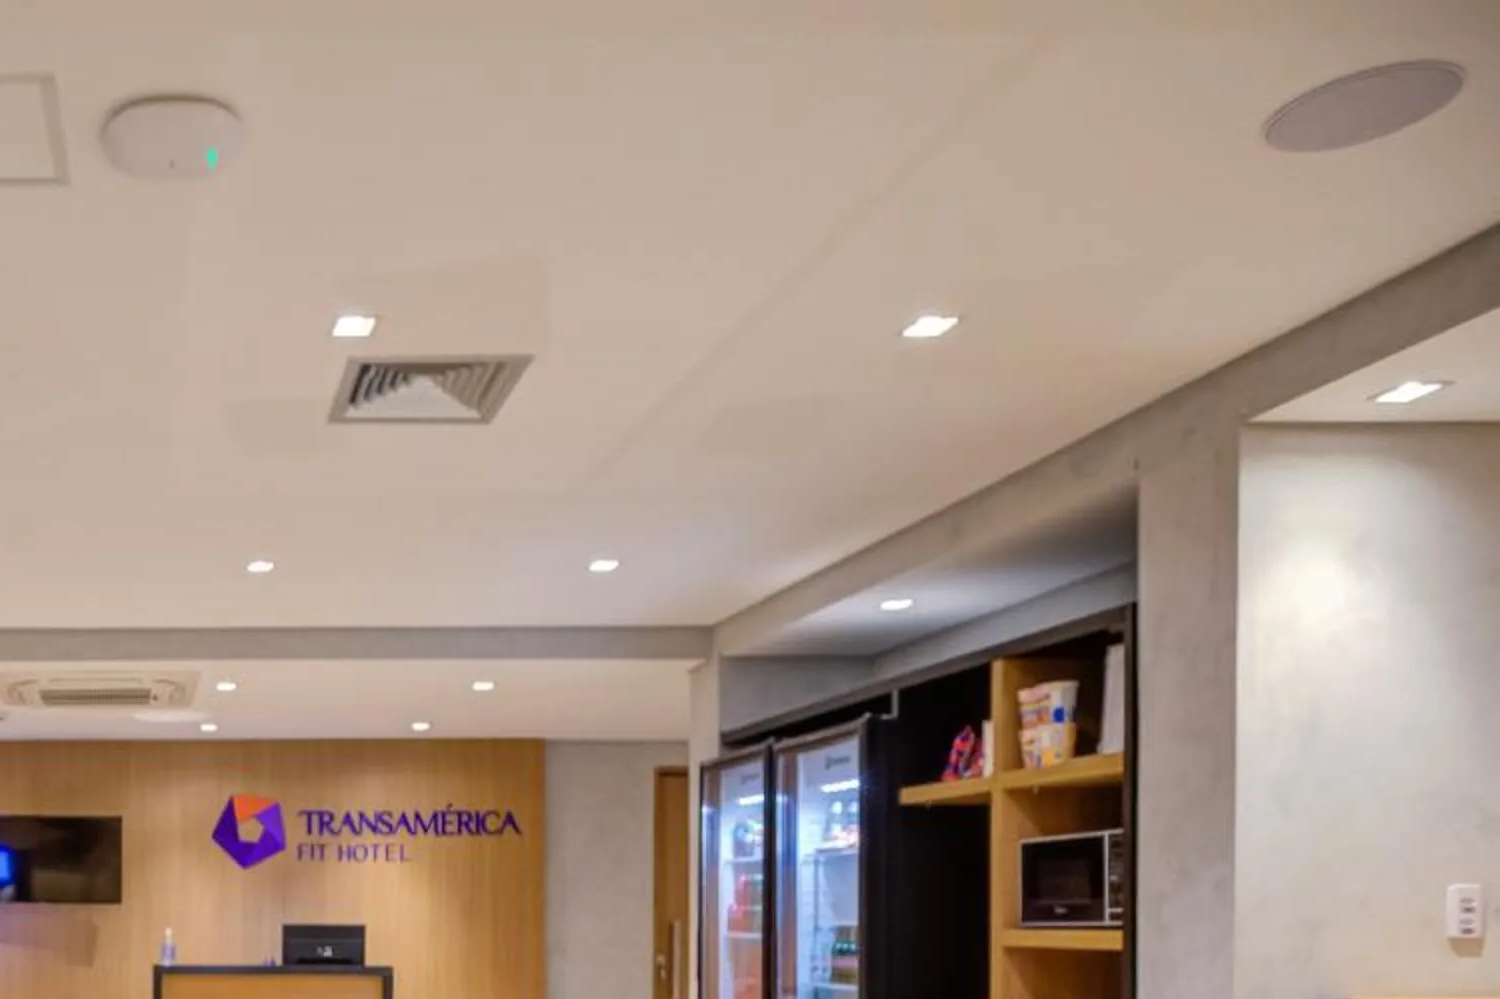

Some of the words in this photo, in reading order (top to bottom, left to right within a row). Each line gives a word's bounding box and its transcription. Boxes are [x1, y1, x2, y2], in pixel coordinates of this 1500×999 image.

[298, 803, 521, 837] TRANSAMÉRICA
[297, 842, 326, 862] FIT
[338, 842, 411, 862] HOTEL
